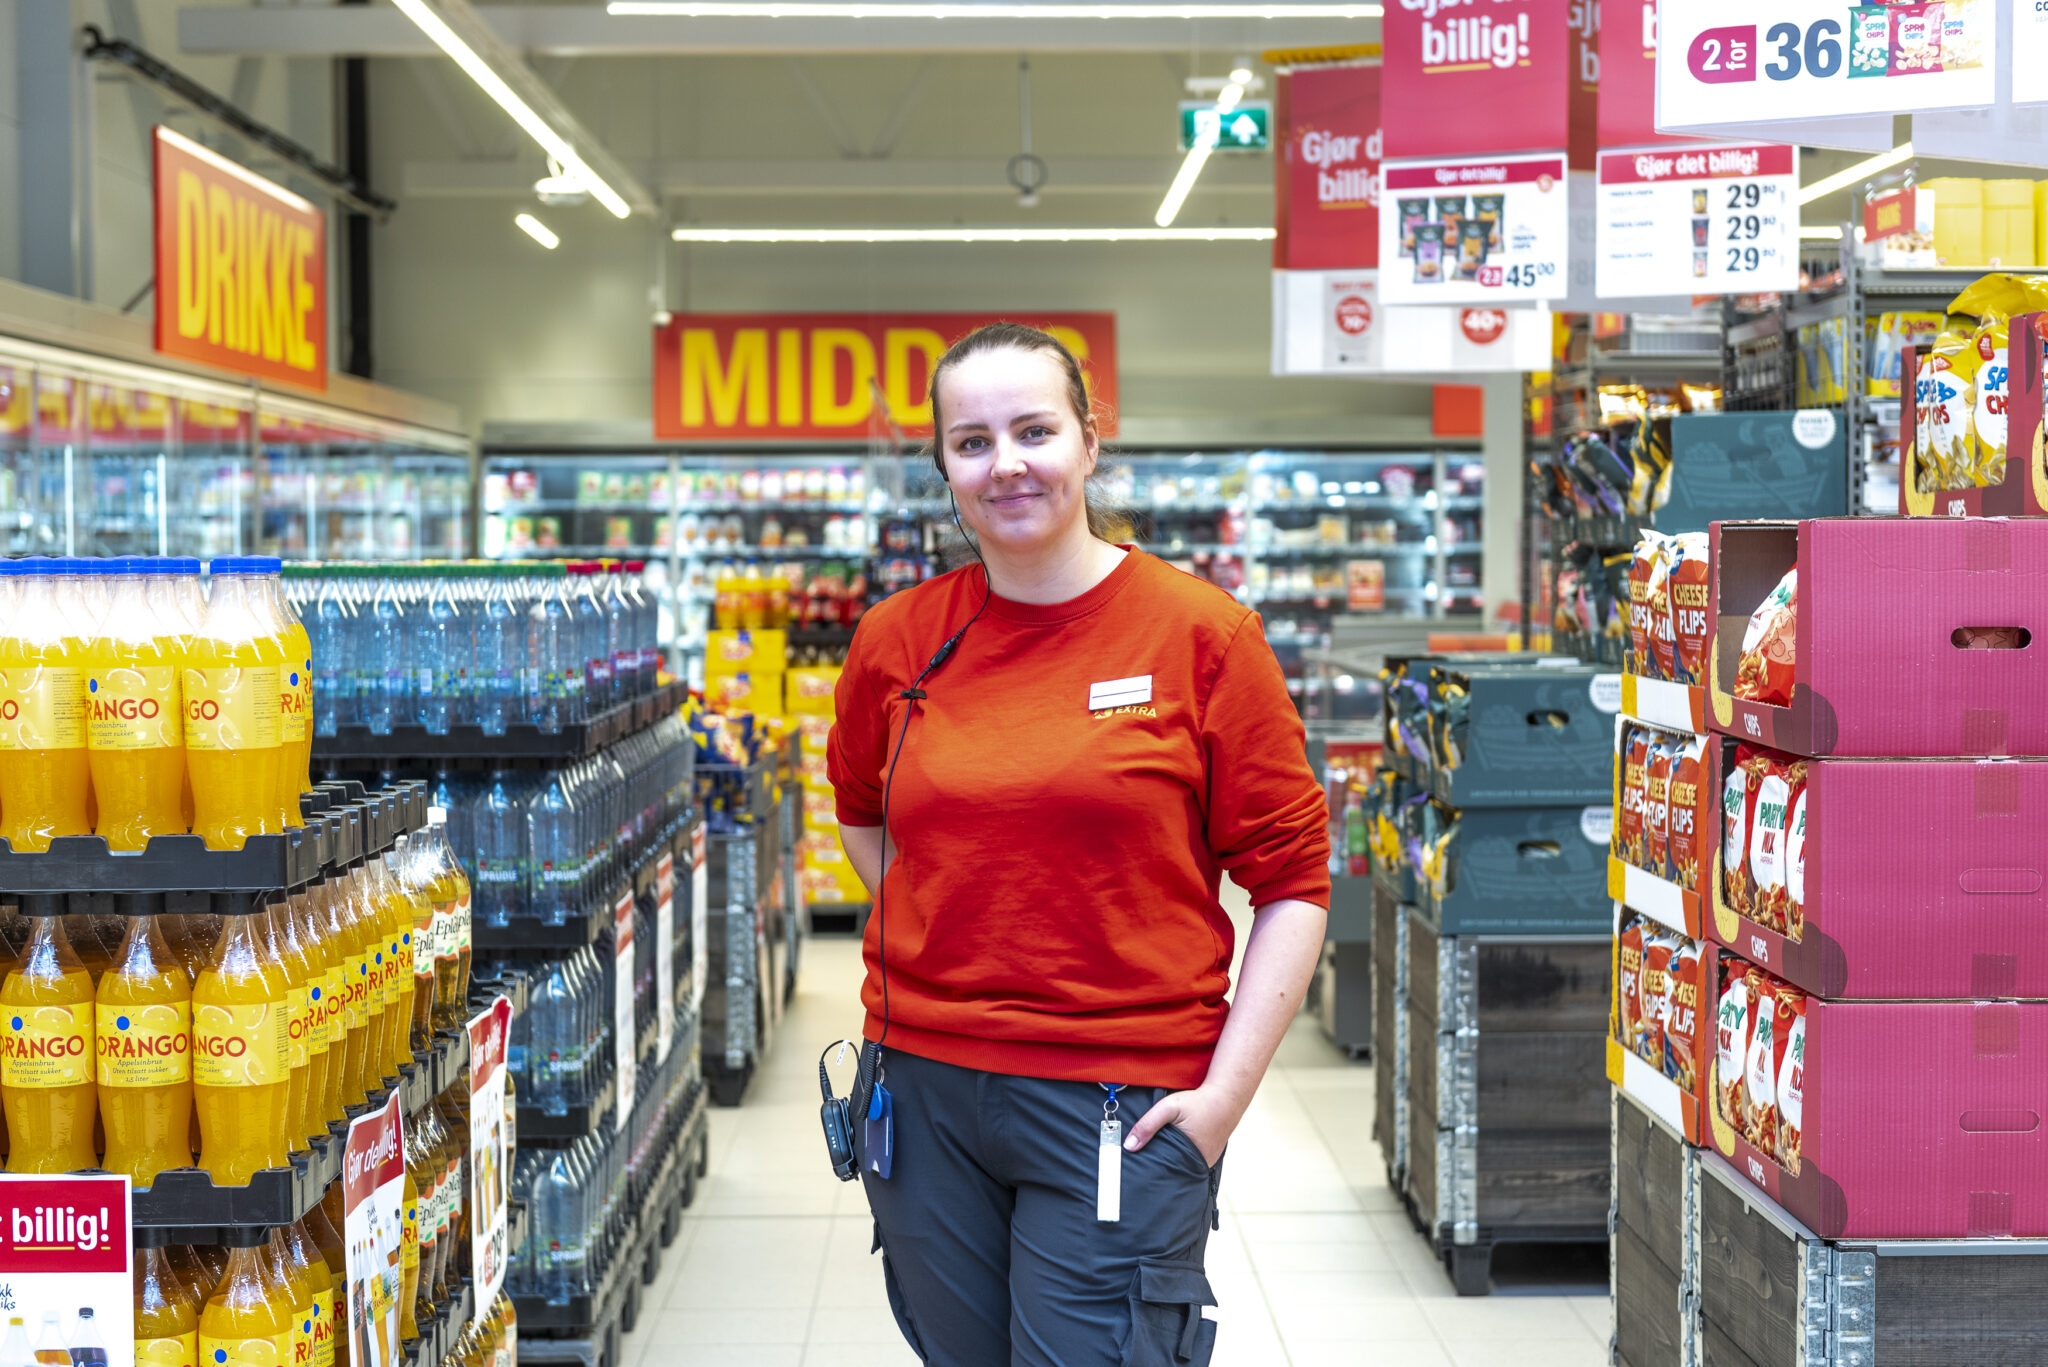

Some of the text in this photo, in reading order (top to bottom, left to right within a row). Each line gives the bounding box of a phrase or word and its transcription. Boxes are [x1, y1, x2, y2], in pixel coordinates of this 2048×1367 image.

[1422, 12, 1530, 68] billig!
[1702, 18, 1842, 81] 2 for 36
[1302, 131, 1361, 168] Gjør
[1635, 150, 1759, 180] Gjør det billig!
[1726, 183, 1760, 209] 29
[1726, 215, 1760, 241] 29
[177, 168, 316, 372] DRIKKE
[1726, 247, 1760, 272] 29
[1506, 264, 1536, 287] 45
[681, 326, 1091, 428] MIDD
[1948, 498, 1967, 517] CHIPS
[1673, 583, 1708, 607] CHEESE
[1678, 609, 1707, 636] FLIPS
[1115, 705, 1157, 718] EXTRA
[1743, 712, 1761, 737] CHIPS
[1671, 780, 1697, 806] CHEESE
[1671, 807, 1693, 835] FLIPS
[1759, 802, 1786, 830] PARTY
[1761, 831, 1776, 855] MIX
[1751, 934, 1769, 963] CHIPS
[98, 1032, 188, 1059] ORANGO
[11, 1059, 56, 1067] Appelsinbrus
[20, 1067, 39, 1075] tilsatt
[40, 1067, 62, 1075] sukker
[112, 1066, 169, 1075] Uten tilsatt sukker
[117, 1058, 163, 1067] Appelsinbrus
[134, 1075, 149, 1083] liter
[347, 1148, 365, 1190] Gjør
[1747, 1155, 1766, 1187] CHIPS
[11, 1206, 109, 1251] billig!
